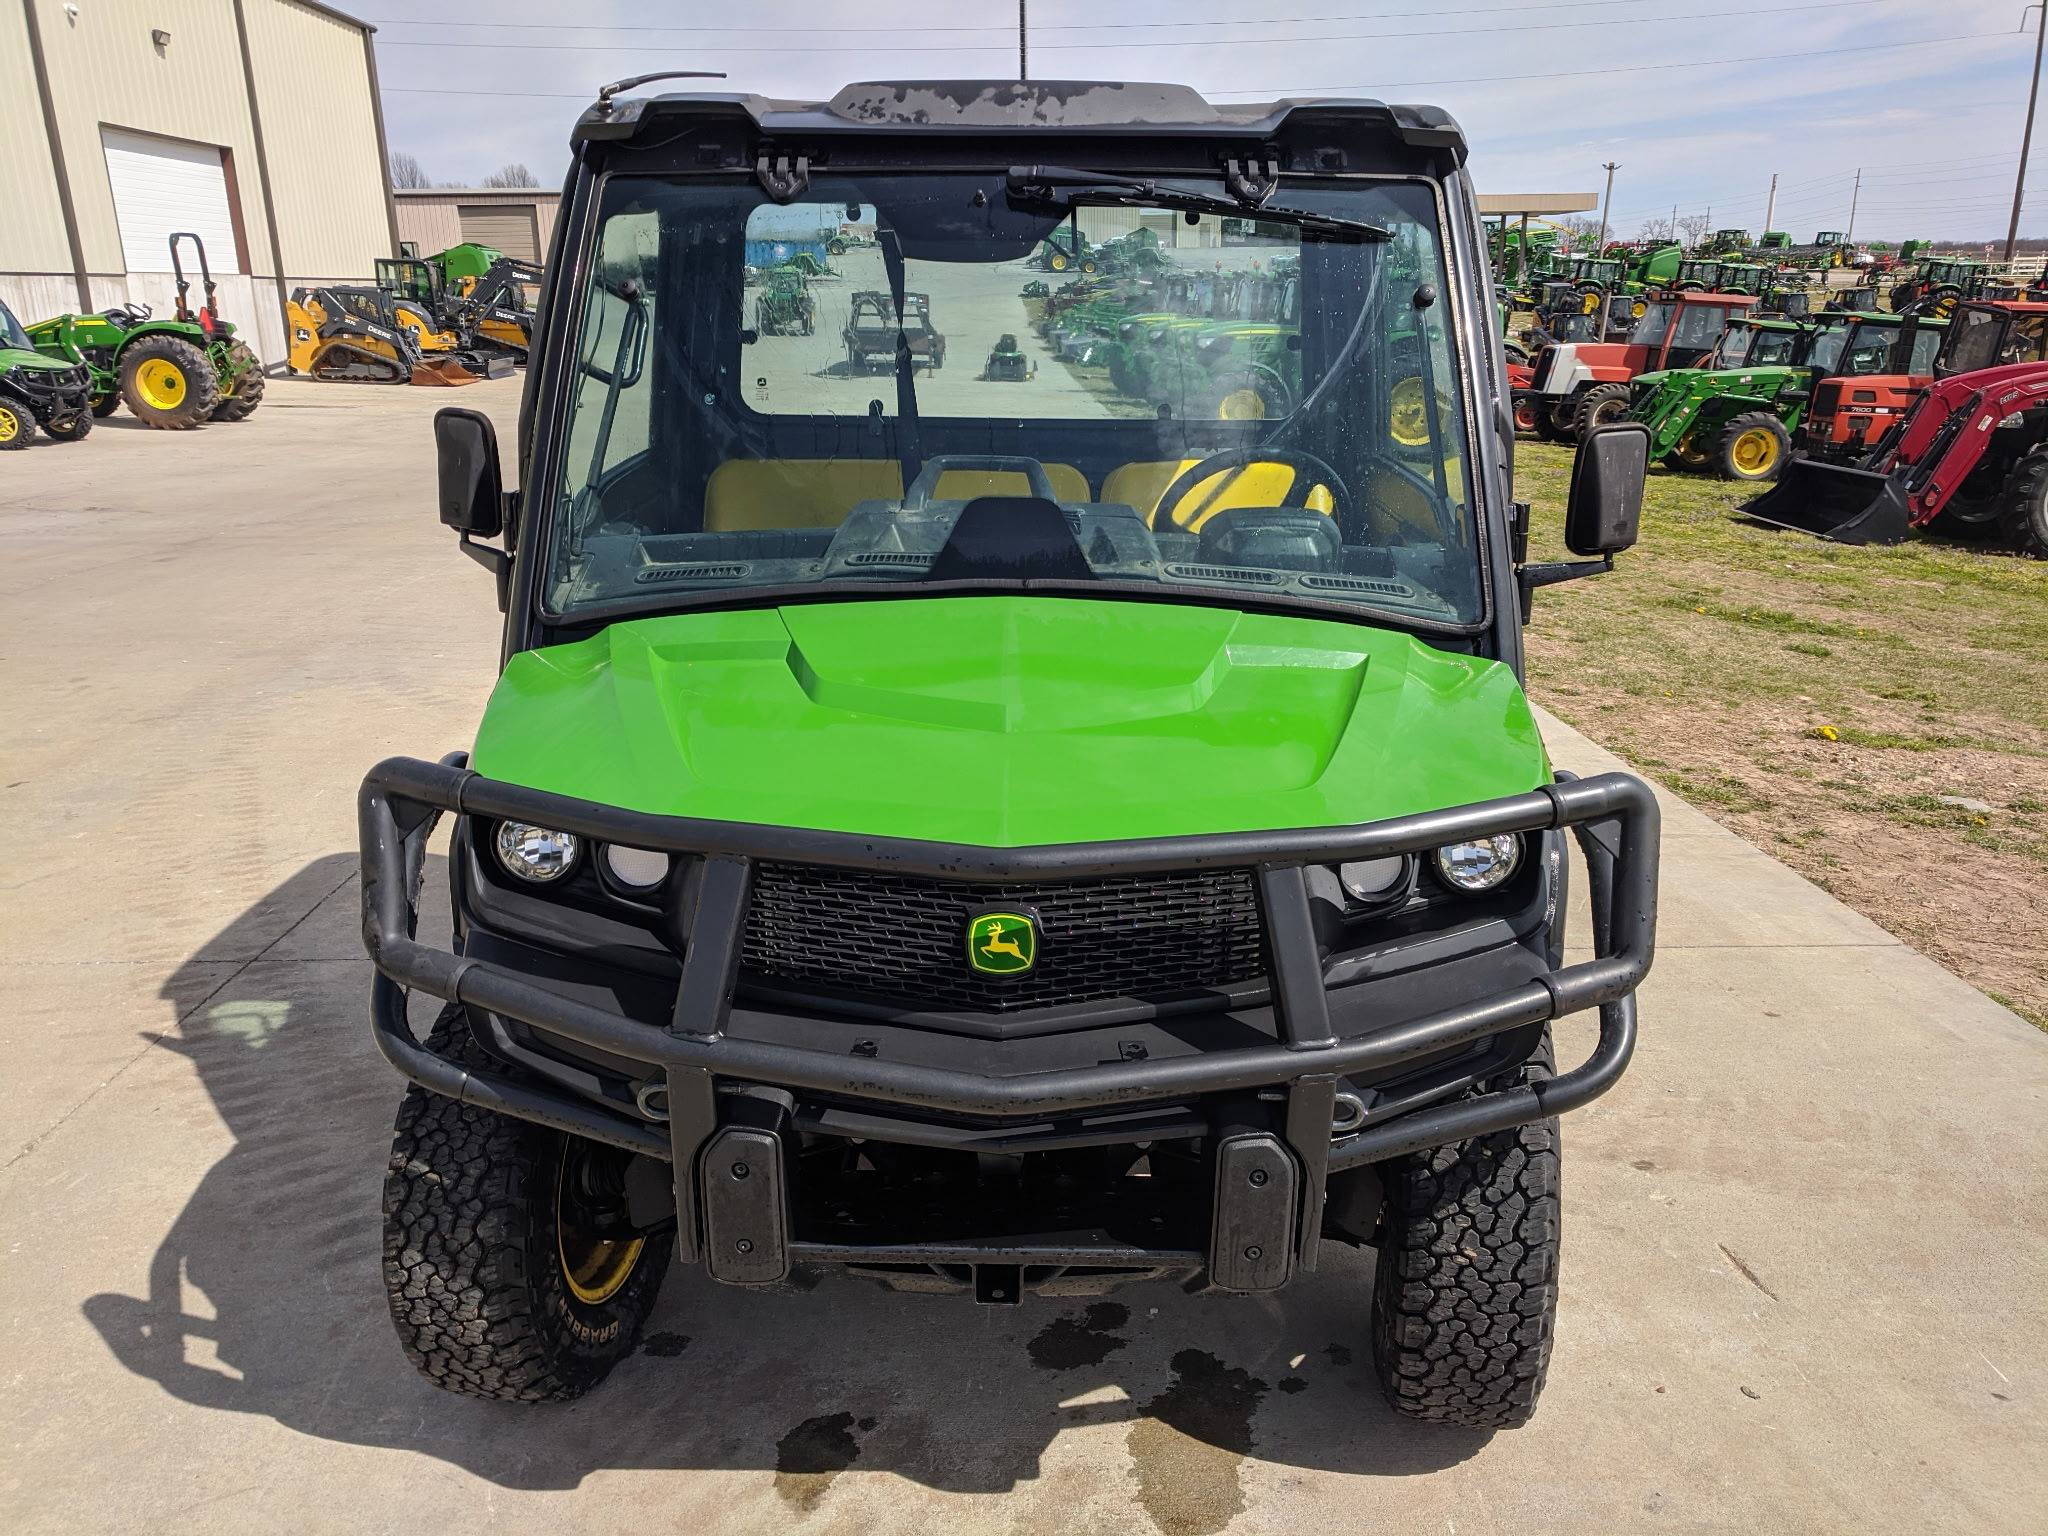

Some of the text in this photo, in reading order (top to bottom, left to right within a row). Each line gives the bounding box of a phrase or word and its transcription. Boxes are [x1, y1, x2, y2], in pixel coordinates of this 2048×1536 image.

[512, 271, 531, 281] DEERE
[495, 311, 516, 321] DEERE
[367, 325, 392, 340] DEERE
[558, 1296, 619, 1344] GRABBER
